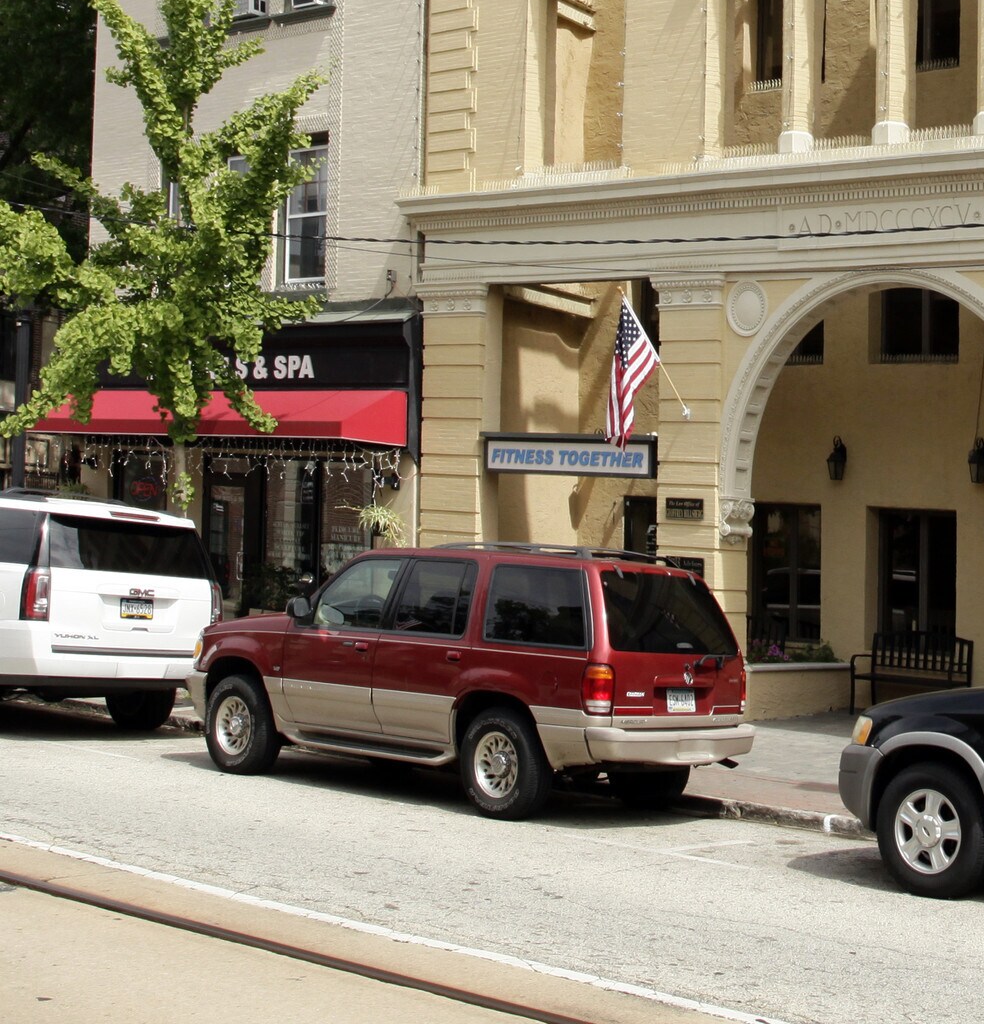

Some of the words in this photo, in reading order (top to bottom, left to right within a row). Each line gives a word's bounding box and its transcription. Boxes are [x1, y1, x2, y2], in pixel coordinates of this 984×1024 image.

[252, 356, 268, 379] &
[273, 355, 315, 379] SPA
[491, 448, 554, 465] FITNESS
[558, 450, 644, 468] TOGETHER
[131, 481, 159, 497] OPEN
[129, 588, 155, 597] GMC
